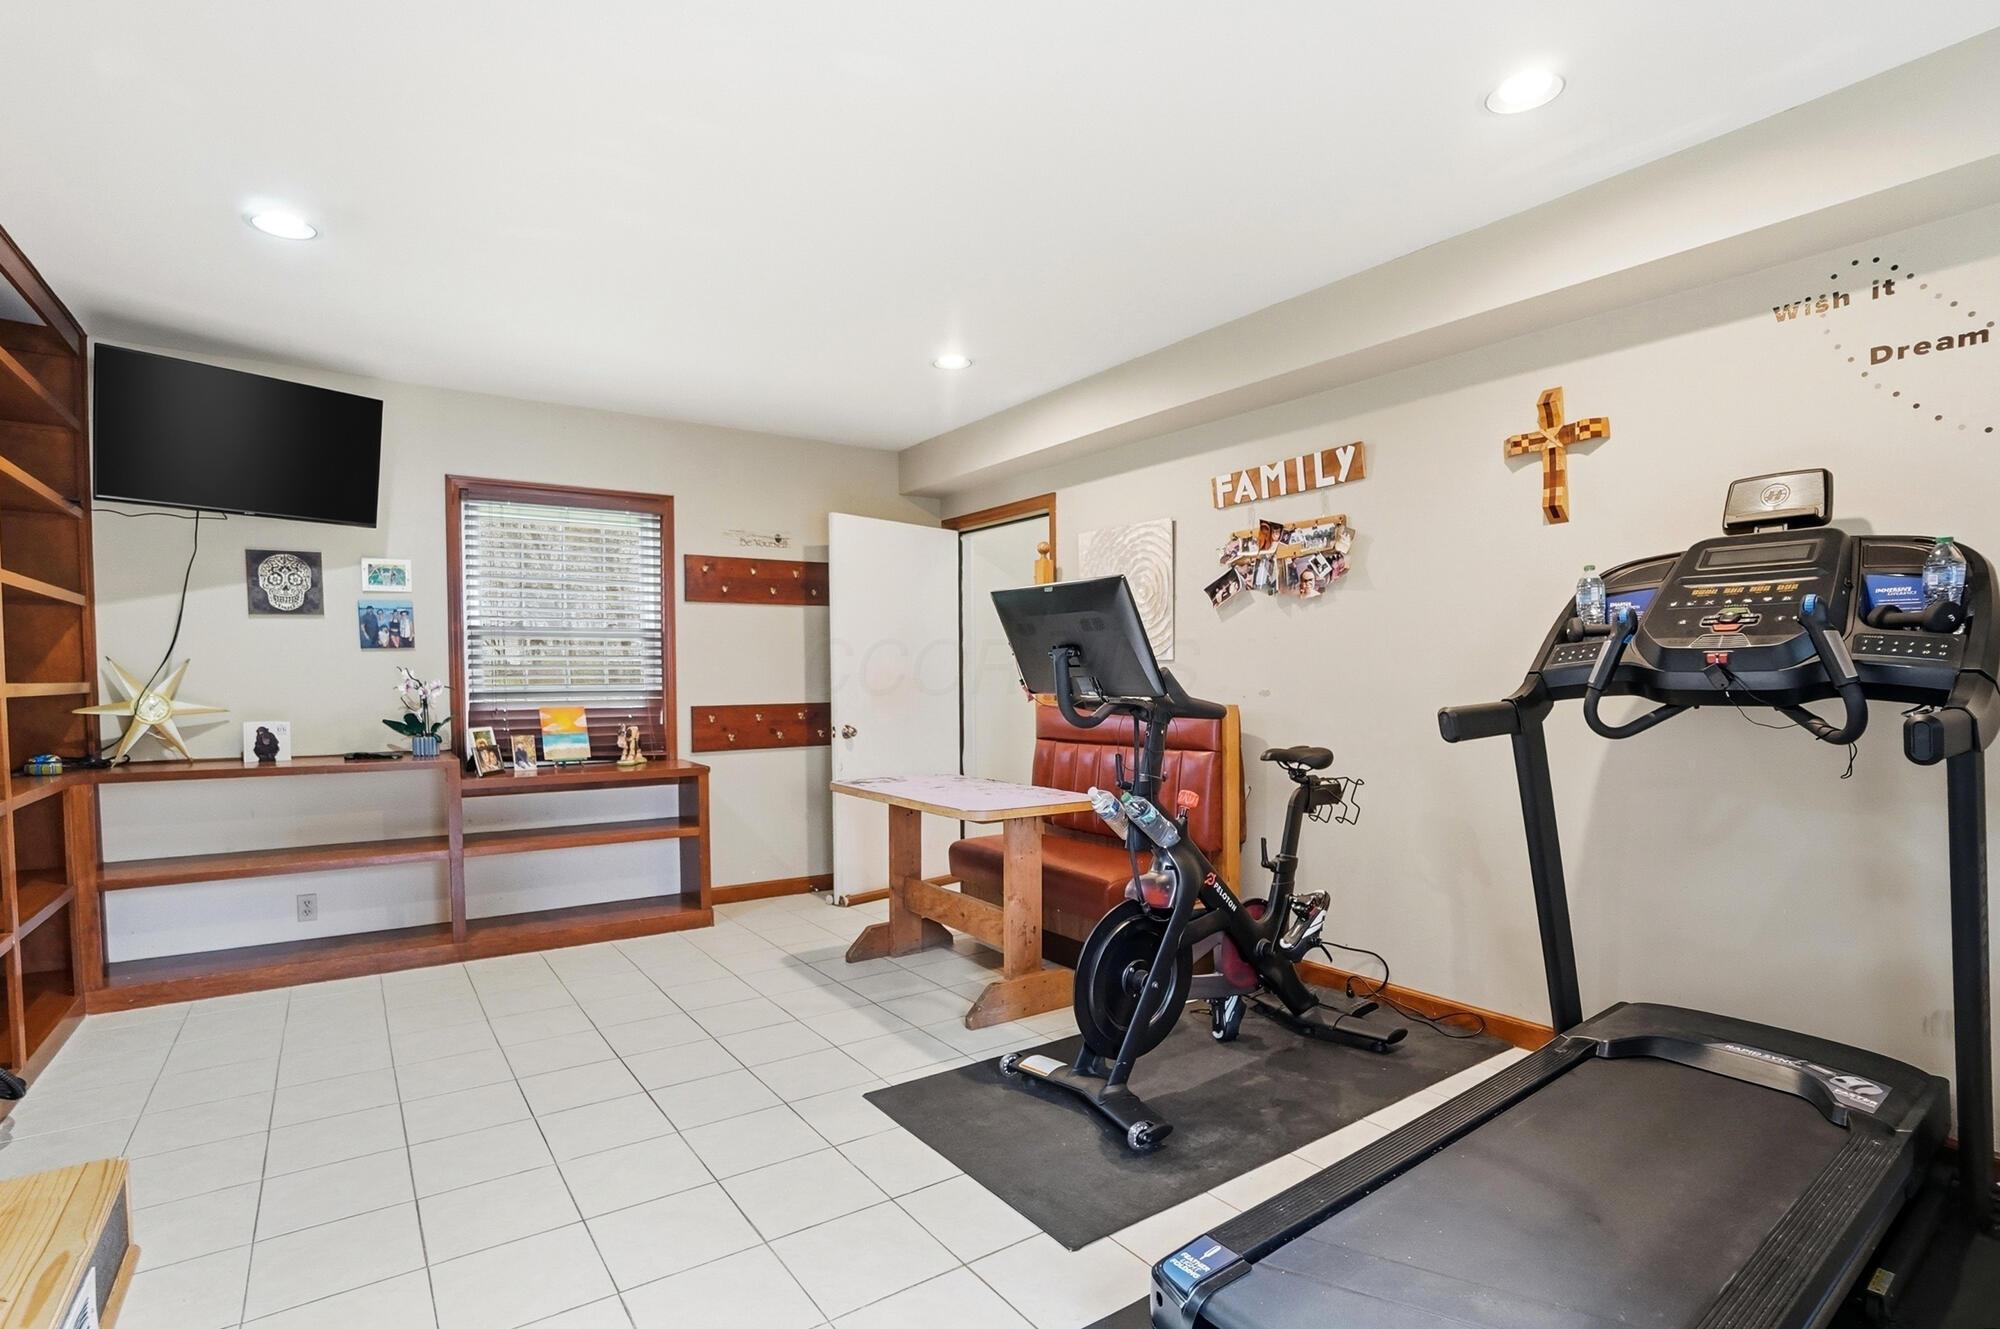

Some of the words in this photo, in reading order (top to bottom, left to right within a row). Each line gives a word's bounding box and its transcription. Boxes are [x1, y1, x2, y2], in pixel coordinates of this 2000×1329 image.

[1773, 291, 1850, 323] Wish
[1872, 278, 1896, 300] it
[1869, 328, 1990, 366] Dream
[1214, 445, 1356, 508] FAMILY
[1213, 882, 1238, 912] PELOTON
[1724, 1044, 1761, 1057] RAPID
